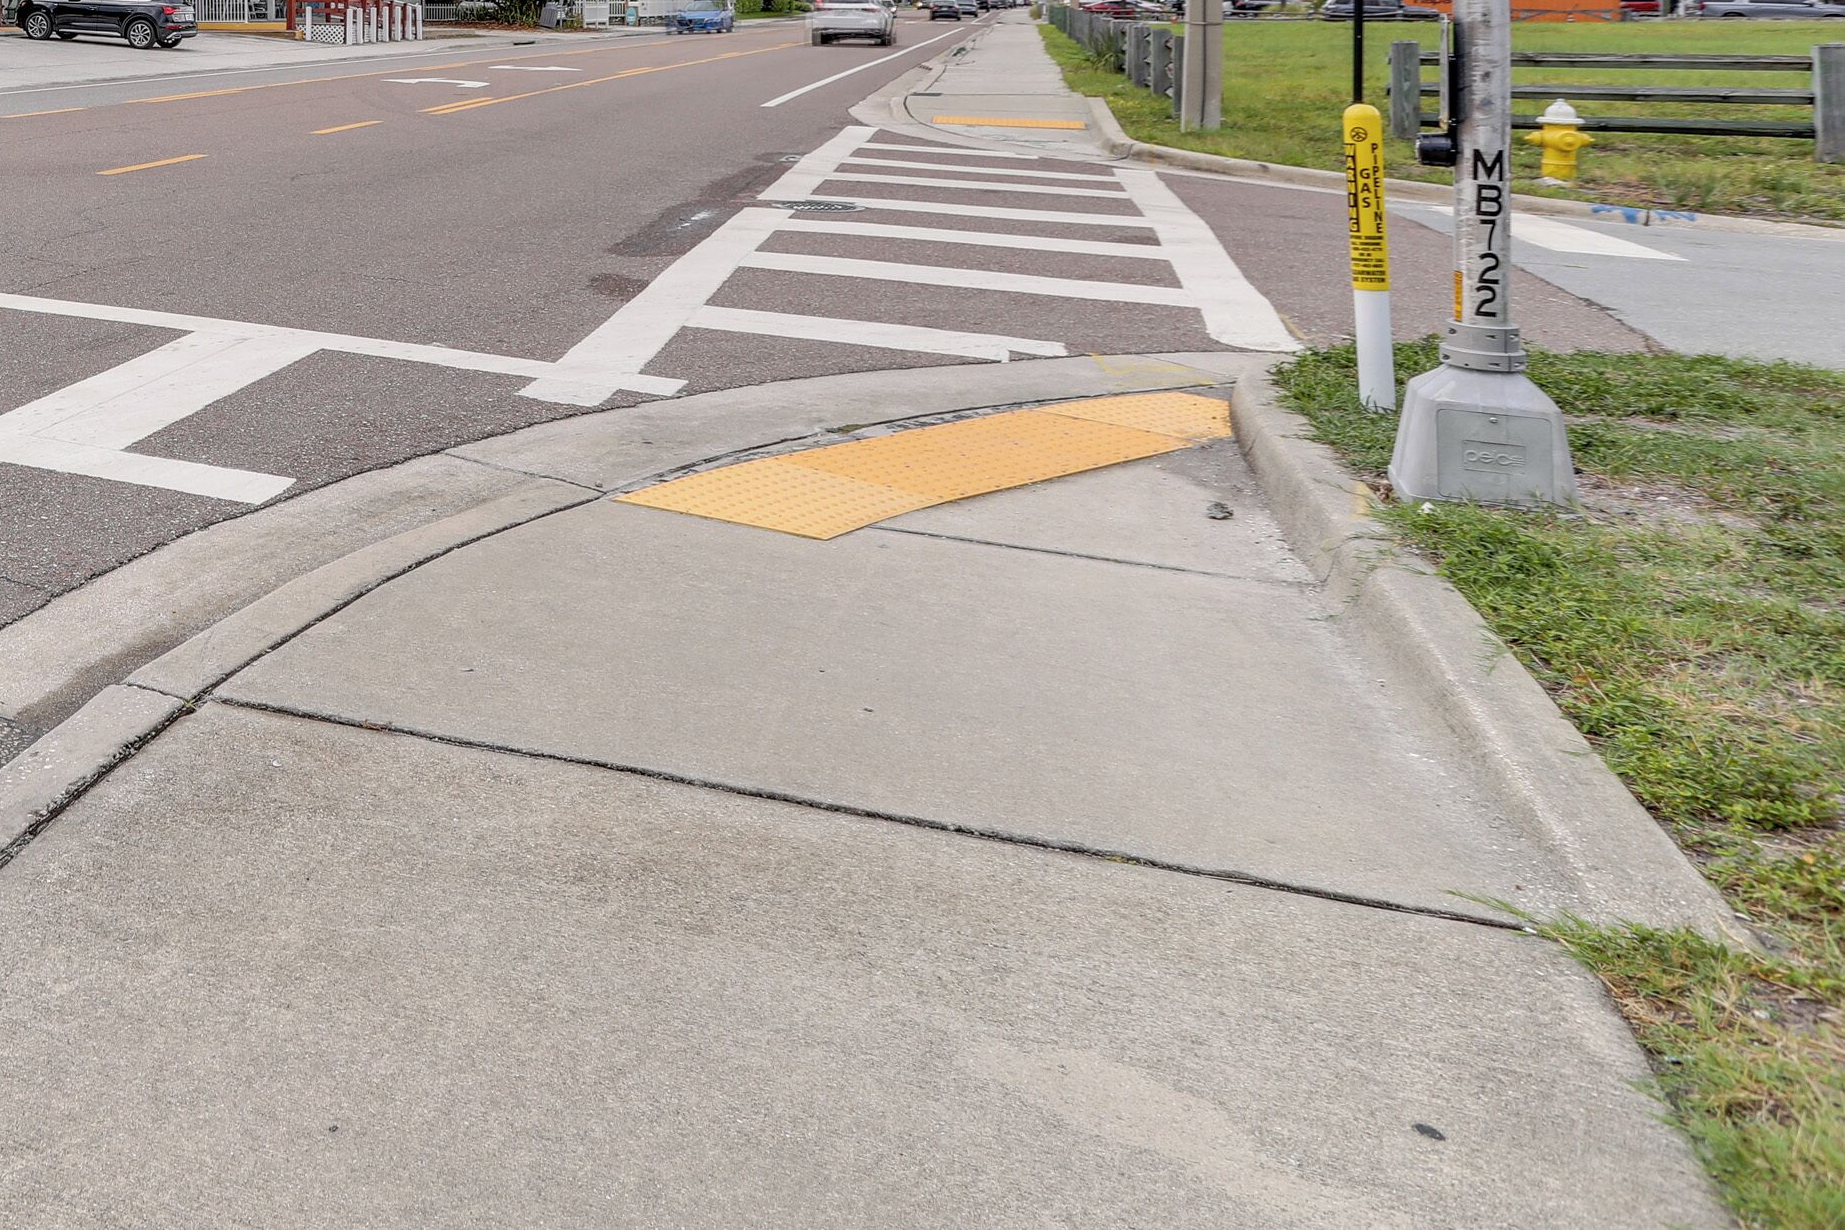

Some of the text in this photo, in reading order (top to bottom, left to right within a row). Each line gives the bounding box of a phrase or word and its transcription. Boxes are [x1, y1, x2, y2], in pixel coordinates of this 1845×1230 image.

[1359, 168, 1372, 208] GAS
[1370, 143, 1384, 234] PIPELINE
[1472, 148, 1504, 318] MB722
